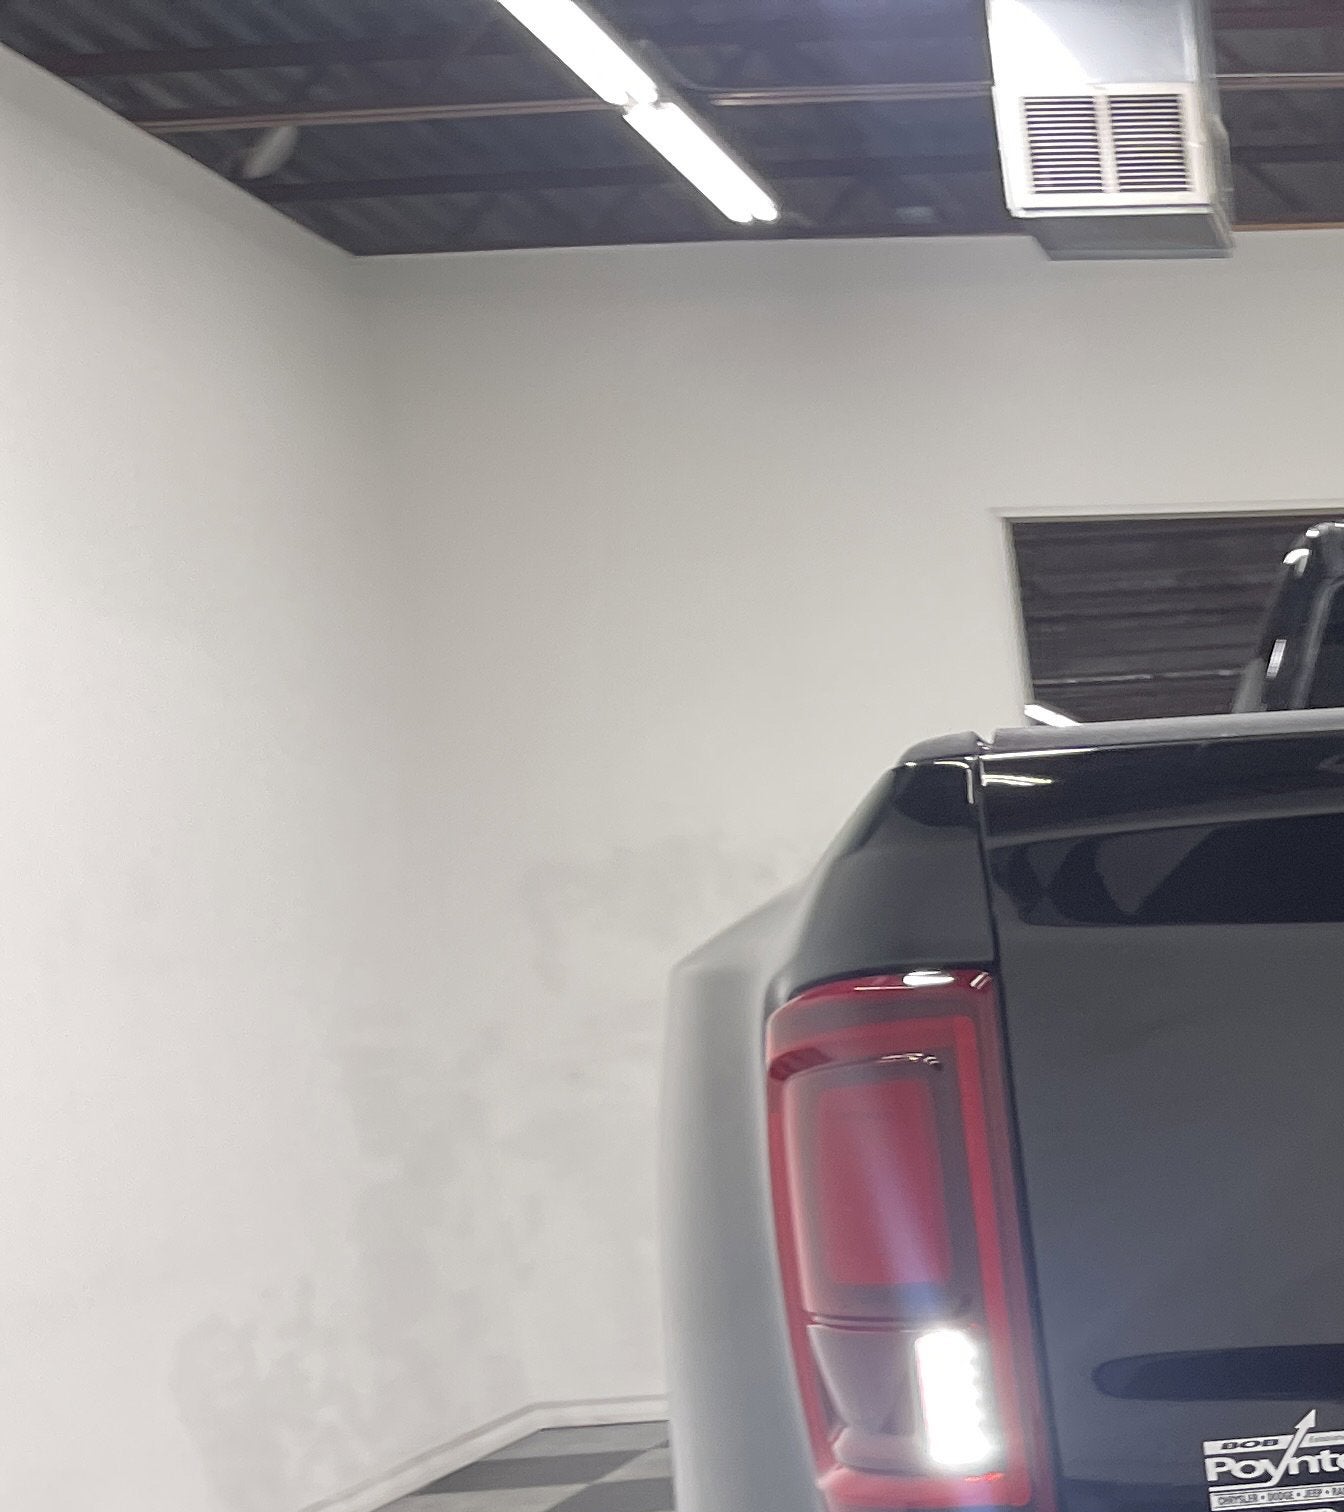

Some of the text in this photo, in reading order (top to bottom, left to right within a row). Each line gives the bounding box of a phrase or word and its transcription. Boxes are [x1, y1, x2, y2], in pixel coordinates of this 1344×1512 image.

[1221, 1438, 1280, 1450] BOB
[1218, 1494, 1258, 1506] CHRYSLER
[1267, 1490, 1295, 1501] DODGE
[1303, 1488, 1323, 1499] JEEP
